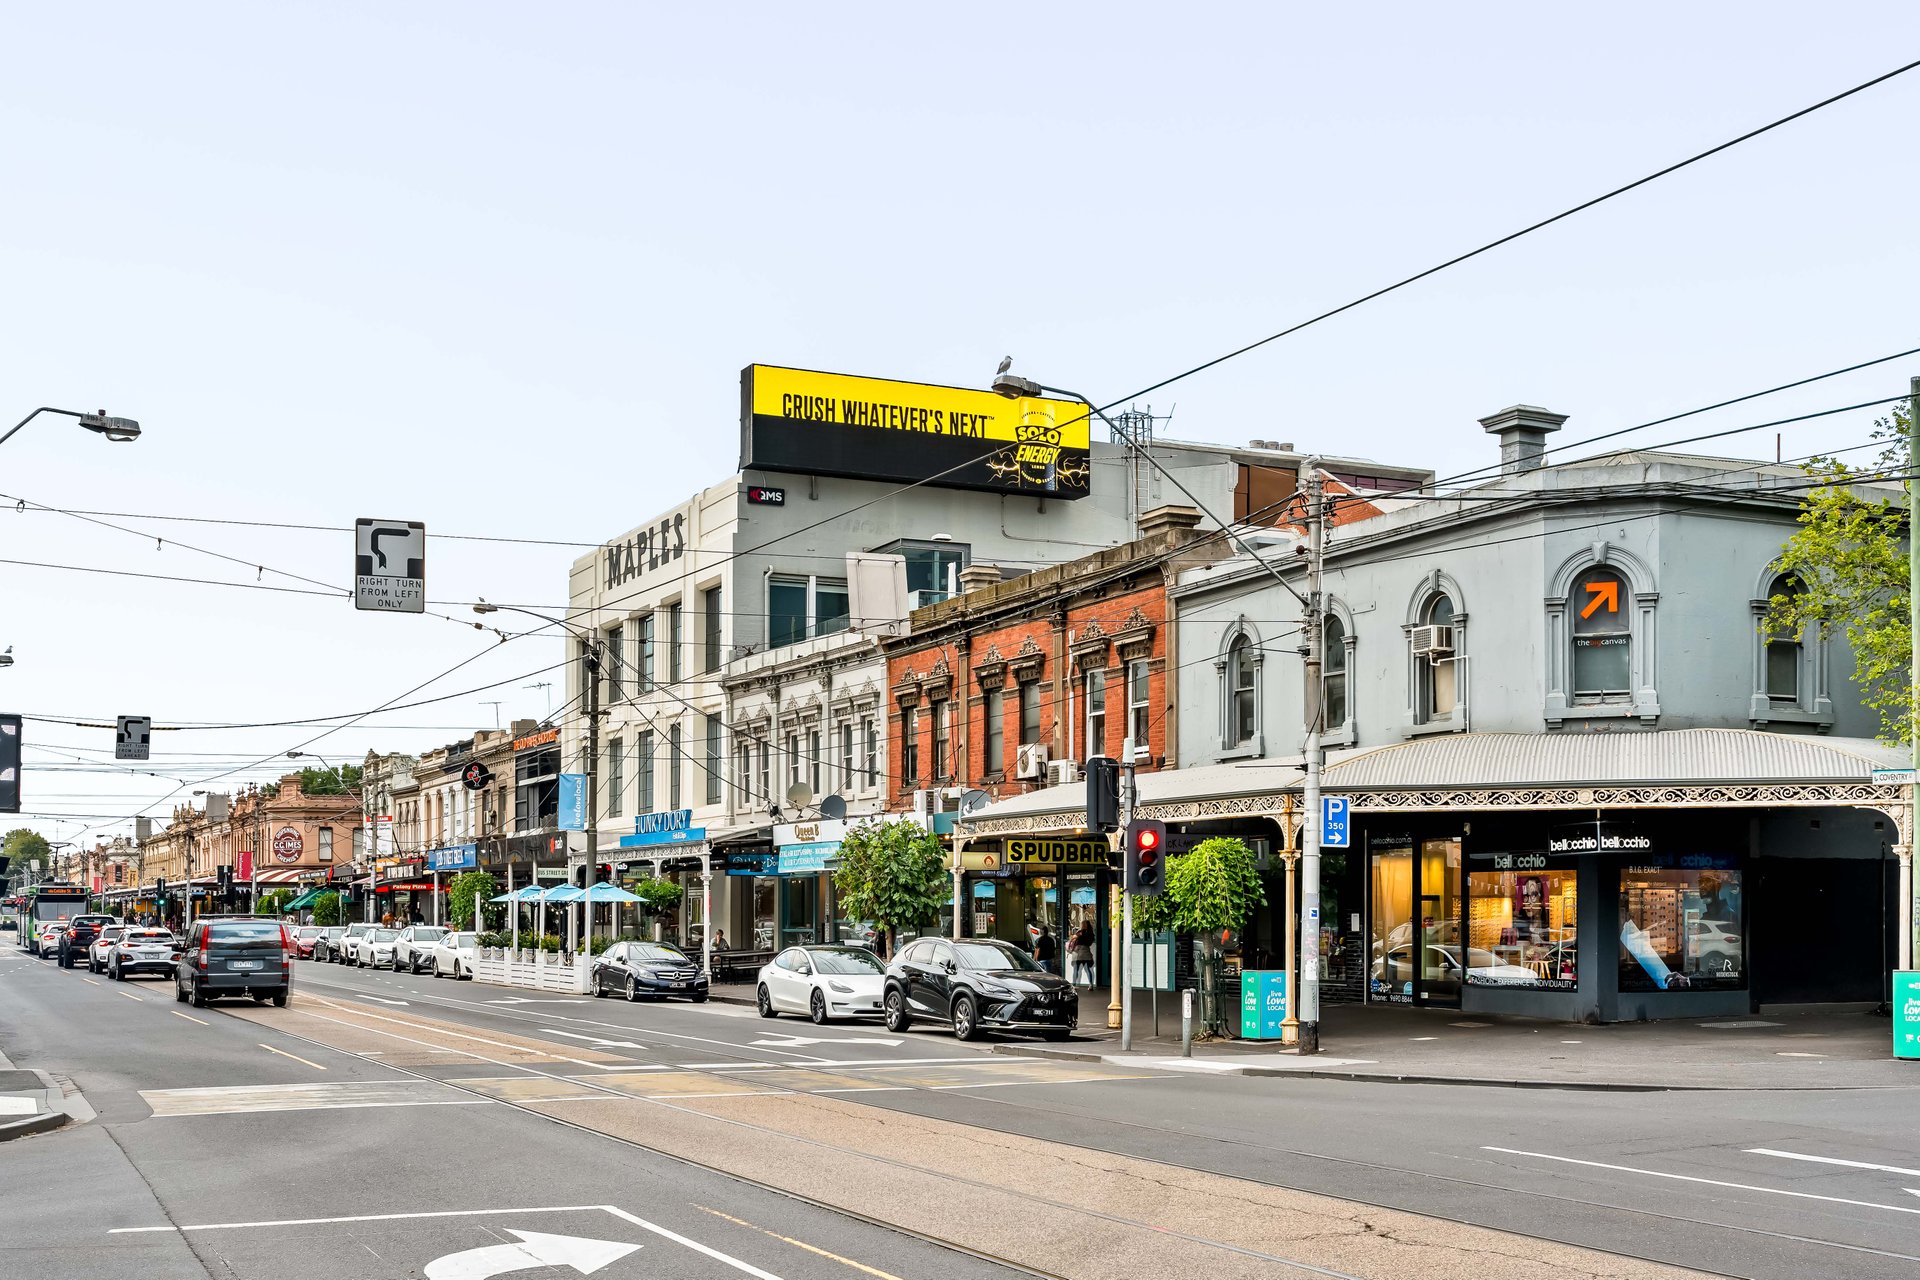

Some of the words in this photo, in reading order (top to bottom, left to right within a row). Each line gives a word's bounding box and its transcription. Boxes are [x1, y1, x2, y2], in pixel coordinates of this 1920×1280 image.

[783, 393, 835, 423] CRUSH
[842, 399, 943, 434] WHATEVER'S
[1017, 426, 1060, 444] SOLO
[1016, 444, 1061, 465] ENERGY
[608, 512, 684, 591] MAPLES
[360, 577, 388, 586] RIGHT
[396, 579, 422, 588] TURN
[361, 587, 388, 597] FROM
[394, 590, 420, 598] LEFT
[378, 599, 403, 608] ONLY
[1328, 799, 1344, 820] P
[634, 812, 662, 834] HUNKY
[664, 810, 687, 832] DORY
[1328, 822, 1344, 830] 350
[794, 824, 812, 839] Queen
[814, 824, 820, 836] B
[1550, 837, 1598, 851] bellocchio
[1601, 836, 1650, 848] bellocchio
[277, 852, 299, 863] CHEMIST
[1010, 842, 1106, 862] SPUDBAR
[1534, 980, 1572, 988] INDIVIDUALITY
[1266, 995, 1286, 1005] Love
[1904, 1003, 1920, 1014] Lov
